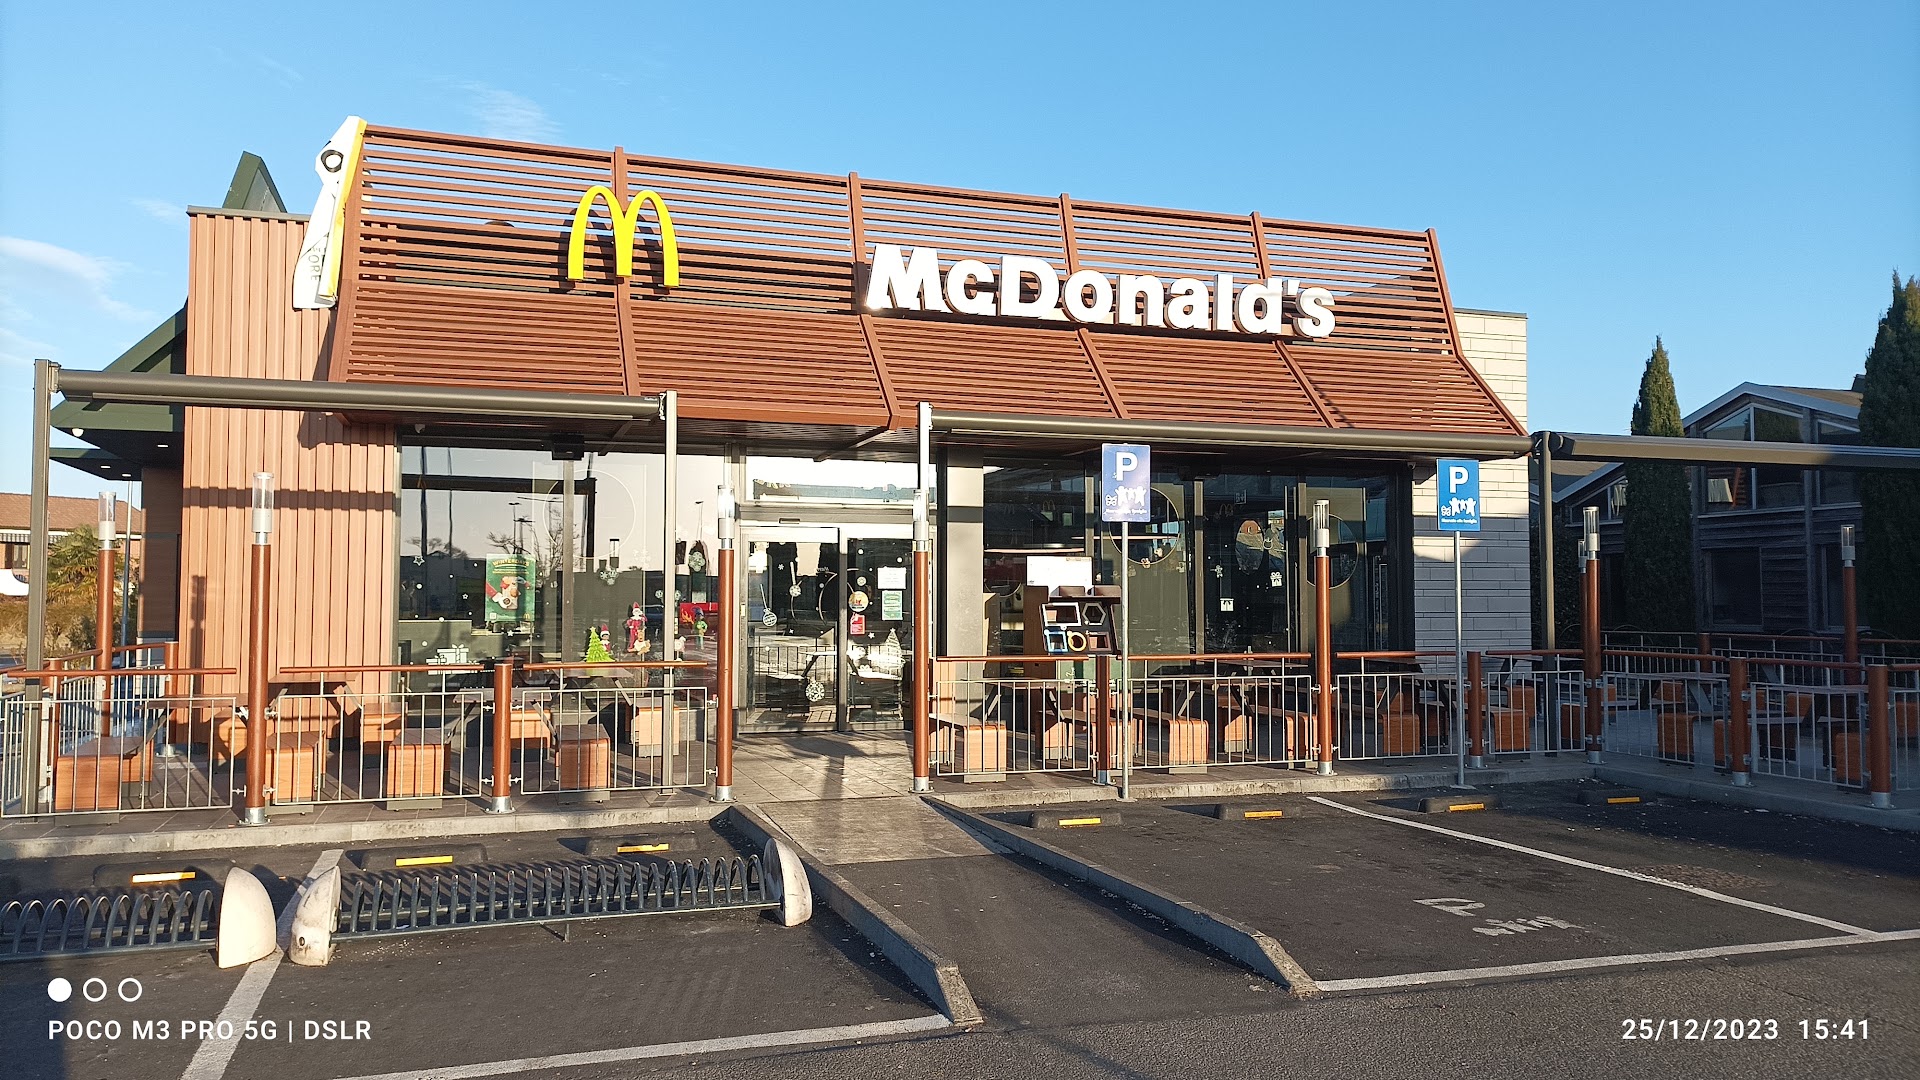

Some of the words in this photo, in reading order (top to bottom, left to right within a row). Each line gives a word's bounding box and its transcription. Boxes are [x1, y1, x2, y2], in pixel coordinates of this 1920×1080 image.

[865, 243, 1337, 339] McDonald's
[1116, 452, 1138, 481] P
[1449, 466, 1469, 494] P
